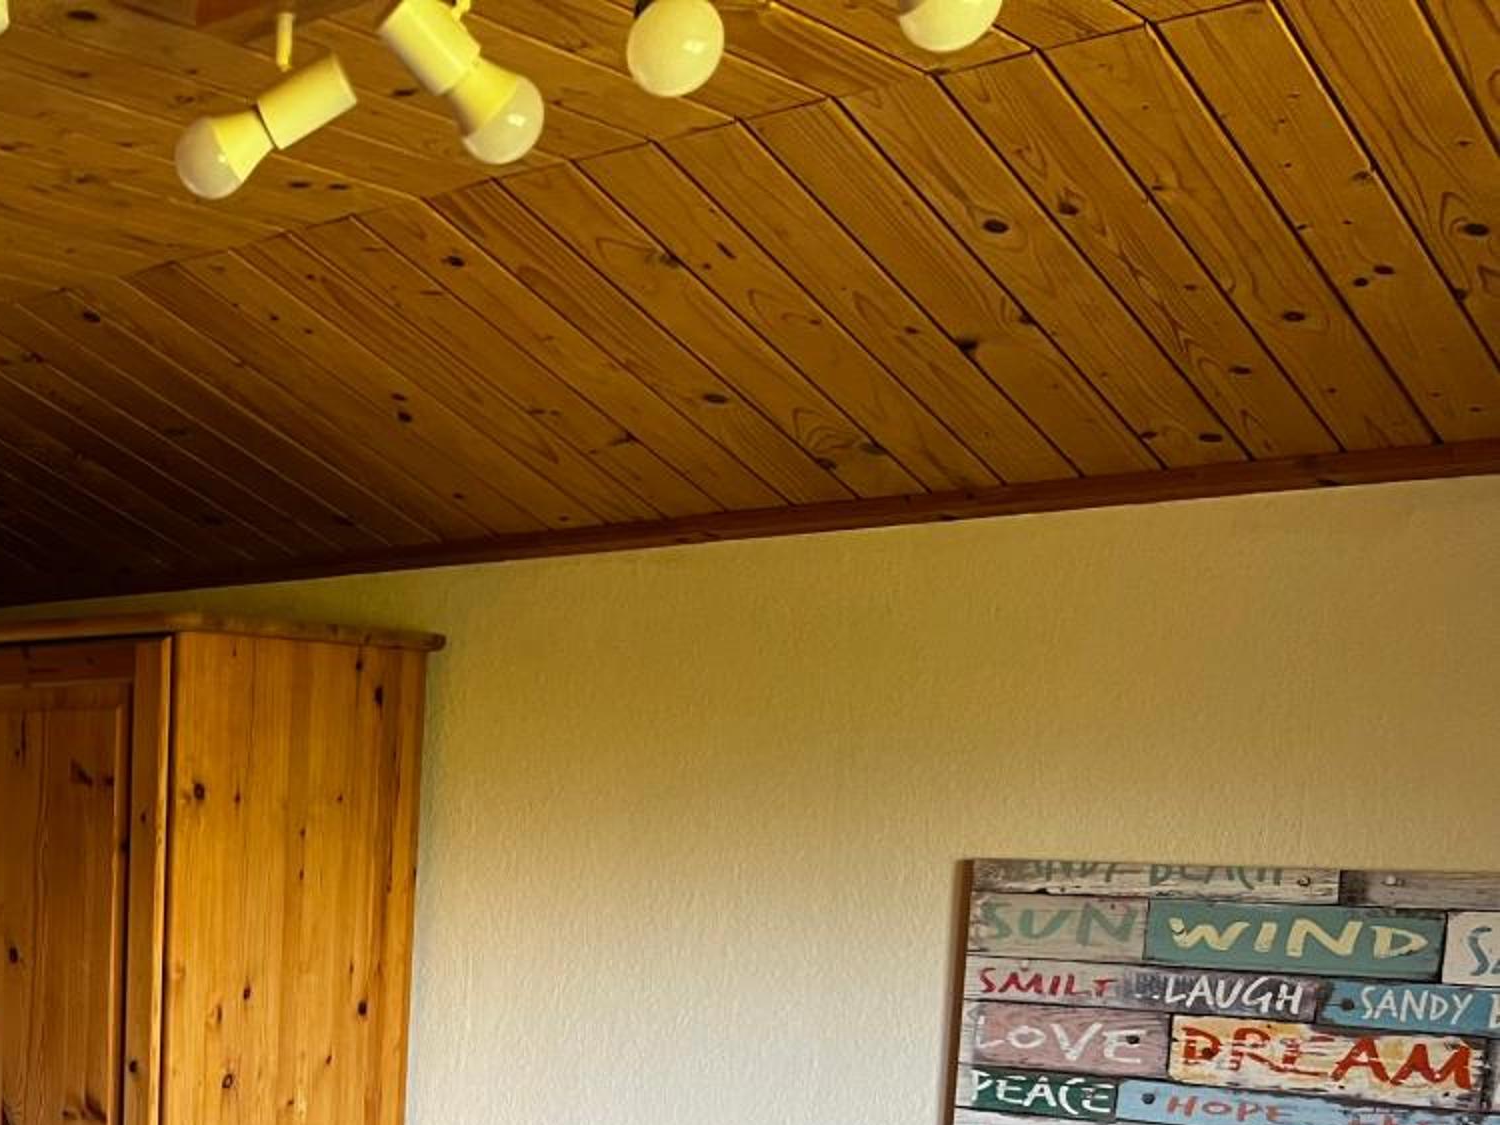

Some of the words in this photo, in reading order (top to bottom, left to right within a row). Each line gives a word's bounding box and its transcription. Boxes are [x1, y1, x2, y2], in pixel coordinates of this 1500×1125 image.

[979, 901, 1139, 946] SUN
[1168, 916, 1429, 960] WIND
[1464, 926, 1500, 976] S
[1165, 975, 1304, 1014] LAUGH
[1361, 986, 1473, 1025] SANDY
[975, 1014, 1147, 1063] LOVE
[1181, 1025, 1472, 1090] DREAM
[970, 1068, 1114, 1115] PEACE
[1166, 1096, 1293, 1122] HOPE
